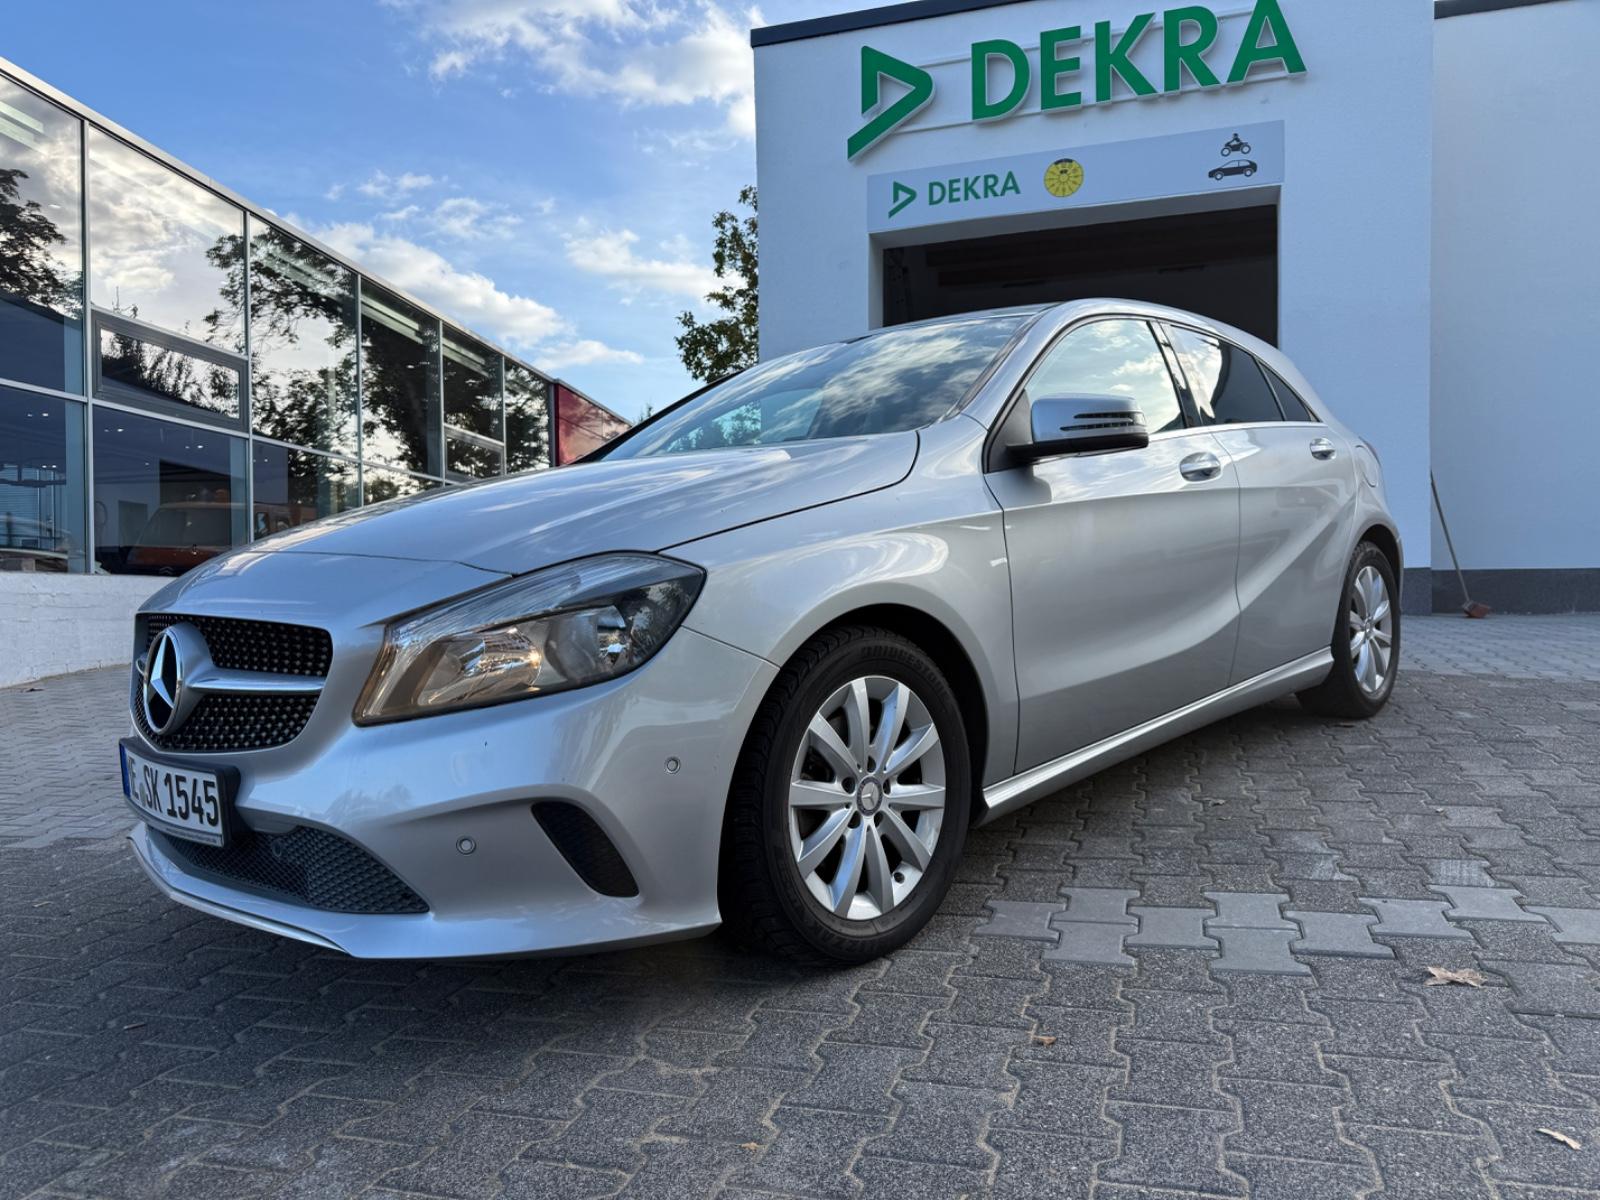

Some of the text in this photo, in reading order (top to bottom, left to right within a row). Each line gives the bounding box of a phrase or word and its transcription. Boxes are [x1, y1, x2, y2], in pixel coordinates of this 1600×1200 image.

[971, 0, 1306, 121] DEKRA
[928, 171, 1021, 206] DEKRA
[143, 765, 162, 813] SK
[164, 773, 219, 827] 1545
